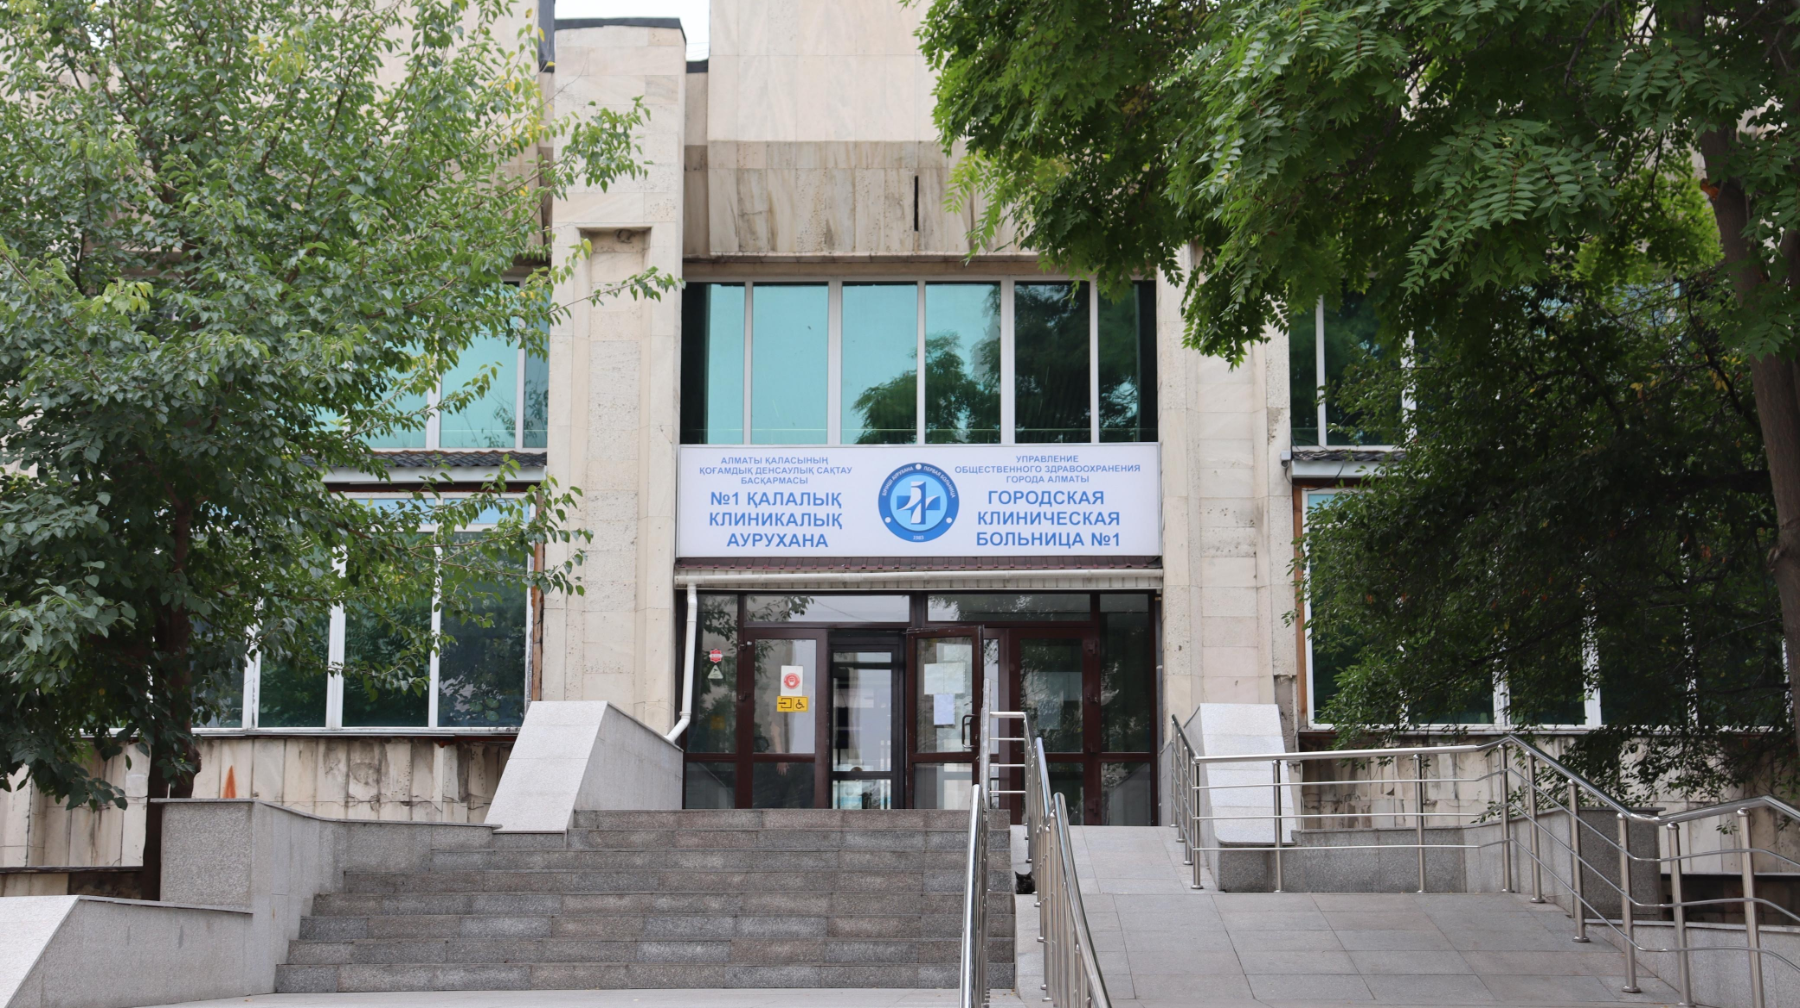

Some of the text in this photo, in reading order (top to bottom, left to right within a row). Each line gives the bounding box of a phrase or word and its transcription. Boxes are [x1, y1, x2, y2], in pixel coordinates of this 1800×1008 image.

[721, 456, 829, 466] АЛМАТЫ ҚАЛАСЫНЫҢ
[1015, 455, 1079, 463] УПРАВЛЕНИЕ
[699, 466, 853, 476] ҚОҒАМДЫҚ ДЕНСАУЛЫҚ САҚТАУ
[954, 464, 1141, 475] ОБЩЕСТВЕННОГО ЗДРАВООХРАНЕНИЯ
[740, 476, 809, 486] БАСҚАРМАСЫ
[1006, 475, 1090, 484] ГОРОДА АЛМАТЫ
[710, 491, 843, 509] №1 ҚАЛАЛЫҚ
[987, 490, 1105, 507] ГОРОДСКАЯ
[709, 512, 843, 530] КЛИНИКАЛЫҚ
[977, 511, 1121, 526] КЛИНИЧЕСКАЯ
[726, 533, 829, 548] АУРУХАНА
[976, 532, 1120, 549] БОЛЬНИЦА №1
